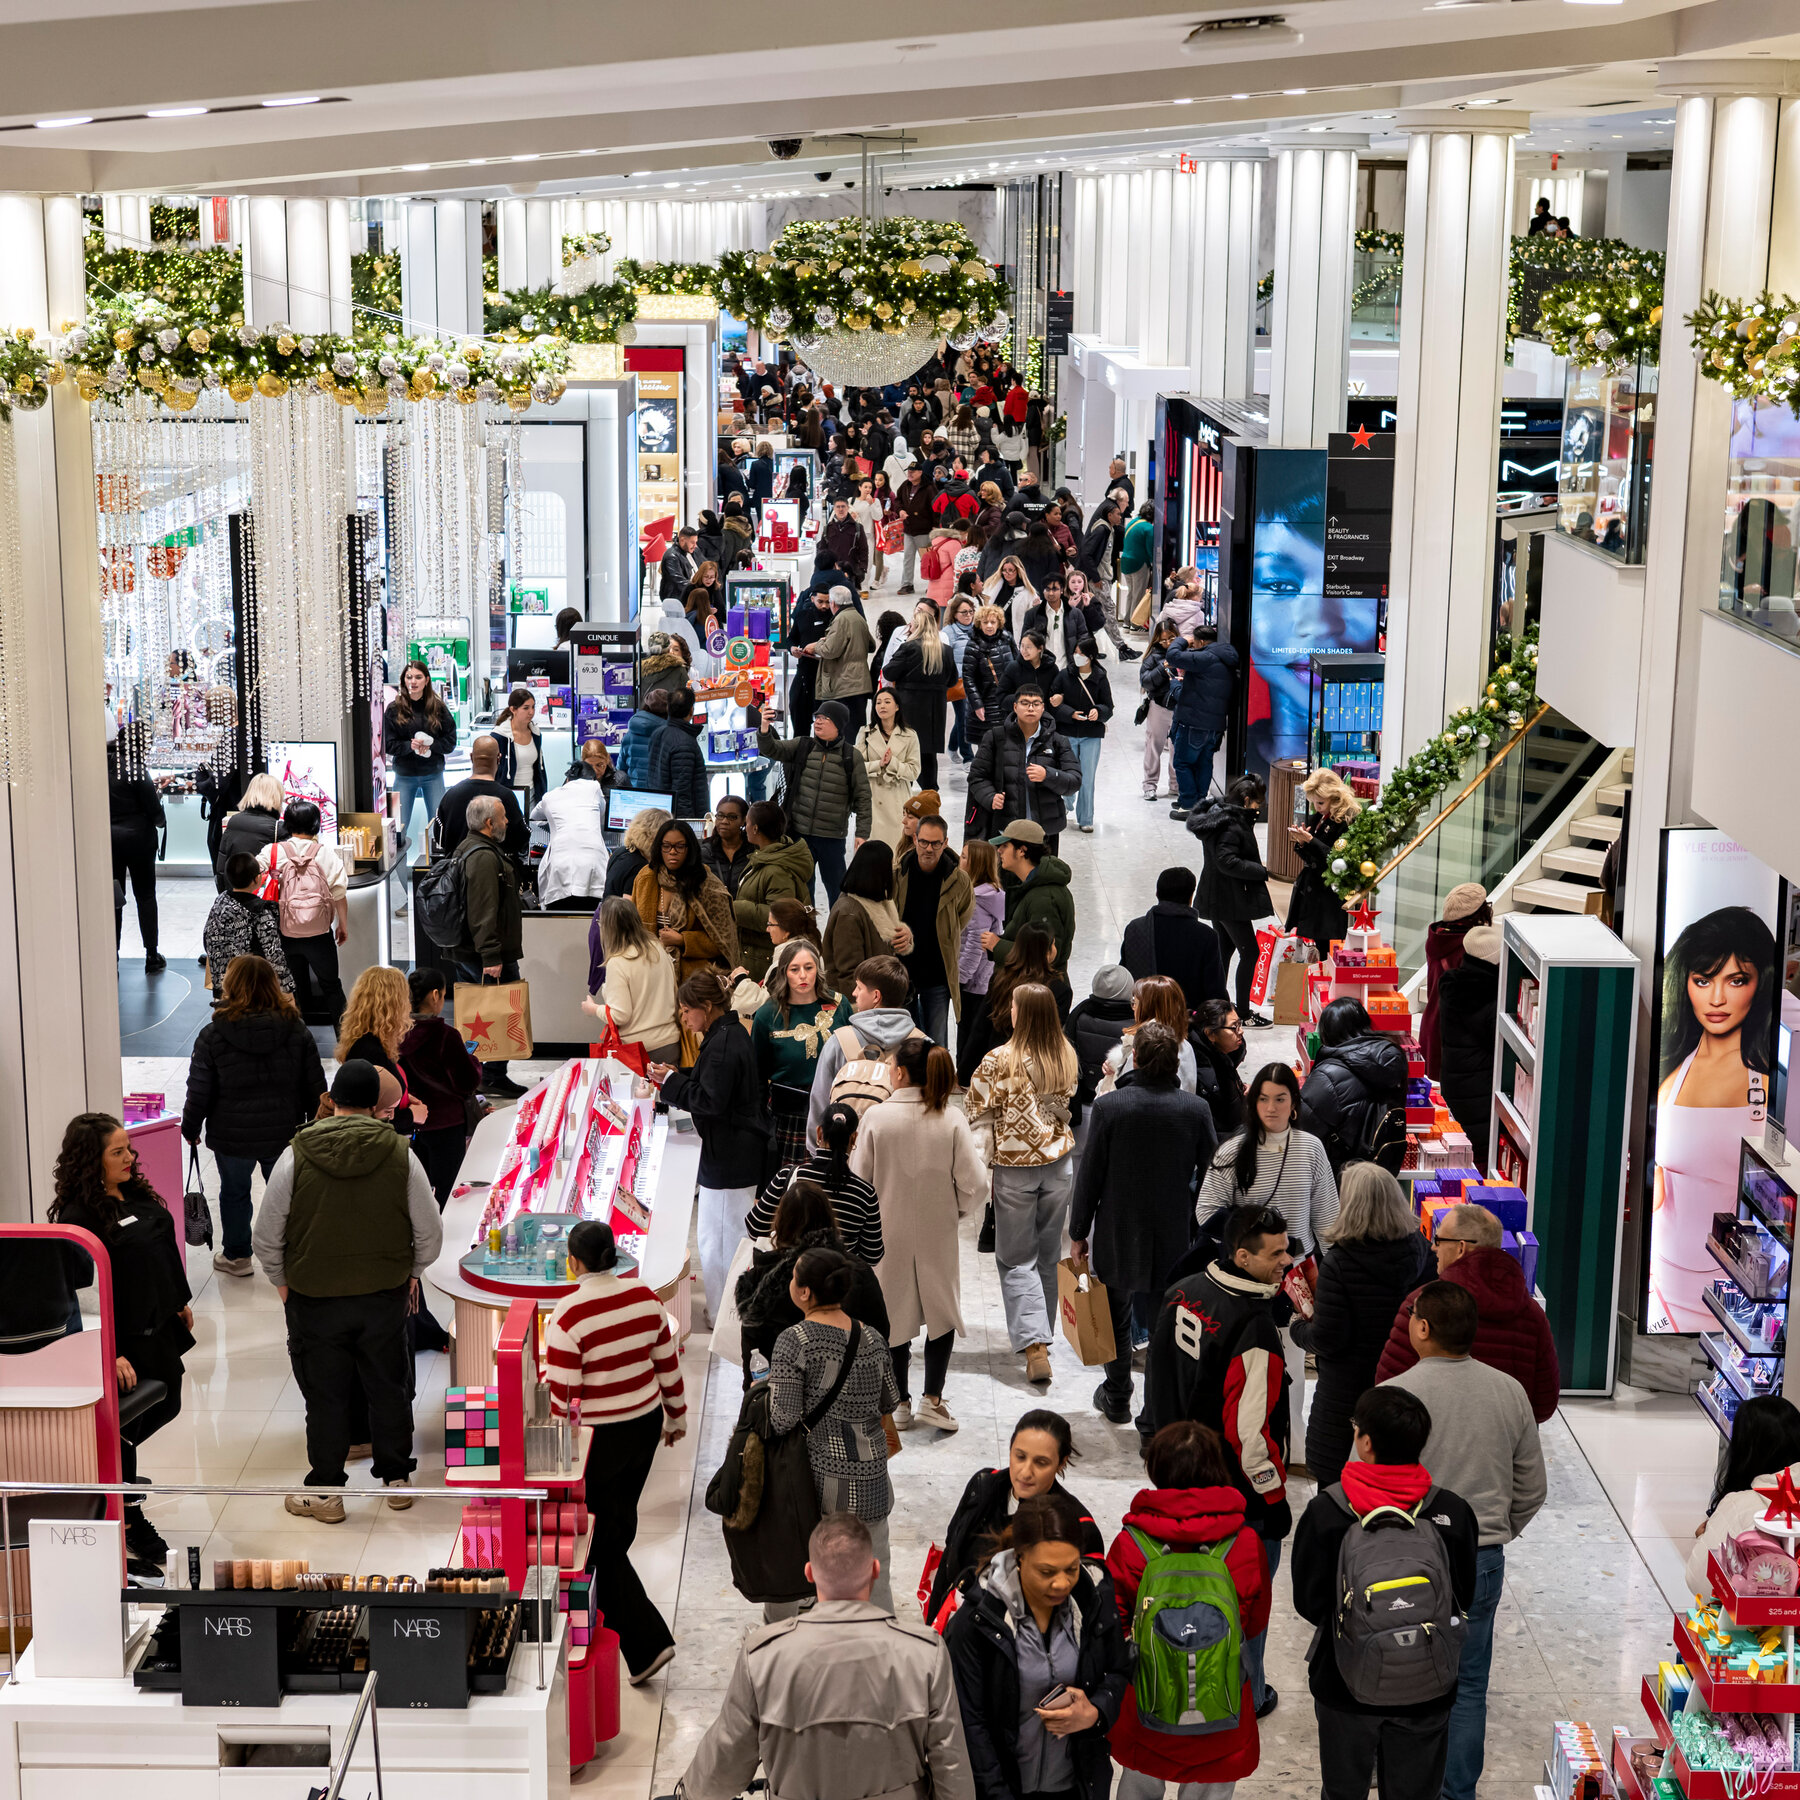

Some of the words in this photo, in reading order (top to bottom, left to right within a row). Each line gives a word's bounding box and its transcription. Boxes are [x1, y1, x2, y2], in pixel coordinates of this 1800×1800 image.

[1340, 554, 1365, 562] Broadway
[587, 634, 619, 642] CLINIQUE
[581, 666, 599, 674] 69.30
[1682, 842, 1707, 853] YLIE
[1711, 842, 1749, 853] COSM
[476, 1040, 498, 1053] acy's
[1175, 1305, 1202, 1360] 8
[50, 1526, 97, 1546] NARS
[1768, 1608, 1783, 1616] $25
[1783, 1608, 1798, 1616] and
[204, 1617, 252, 1637] NARS
[393, 1618, 441, 1638] NARS
